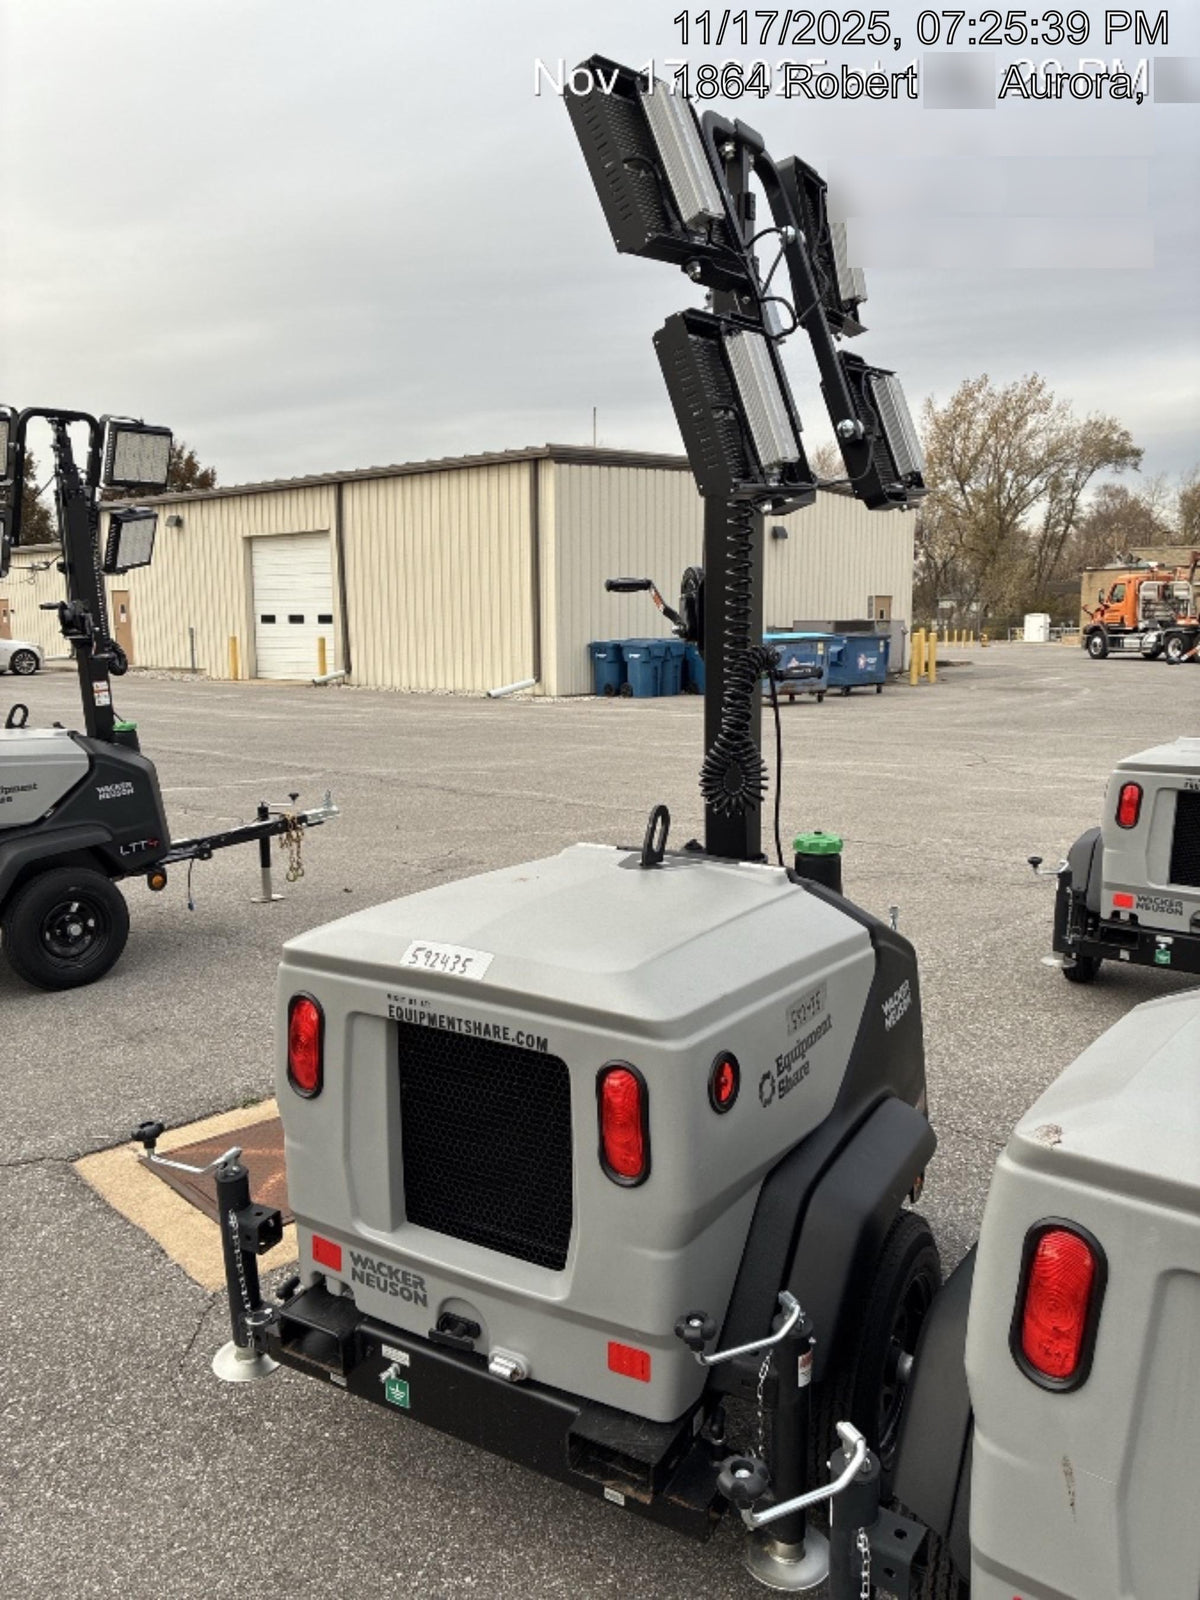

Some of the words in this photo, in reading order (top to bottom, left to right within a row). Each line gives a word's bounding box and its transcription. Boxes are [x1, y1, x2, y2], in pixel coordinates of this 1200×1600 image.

[1136, 895, 1184, 908] WACKER
[1136, 903, 1184, 916] NEUSON
[409, 947, 474, 974] 592435
[388, 1004, 548, 1051] EQUIPMENTSHARE.COM
[775, 1014, 833, 1077] Equipment
[778, 1061, 811, 1099] Share
[350, 1251, 427, 1293] WACKER
[351, 1268, 428, 1307] NEUSON
